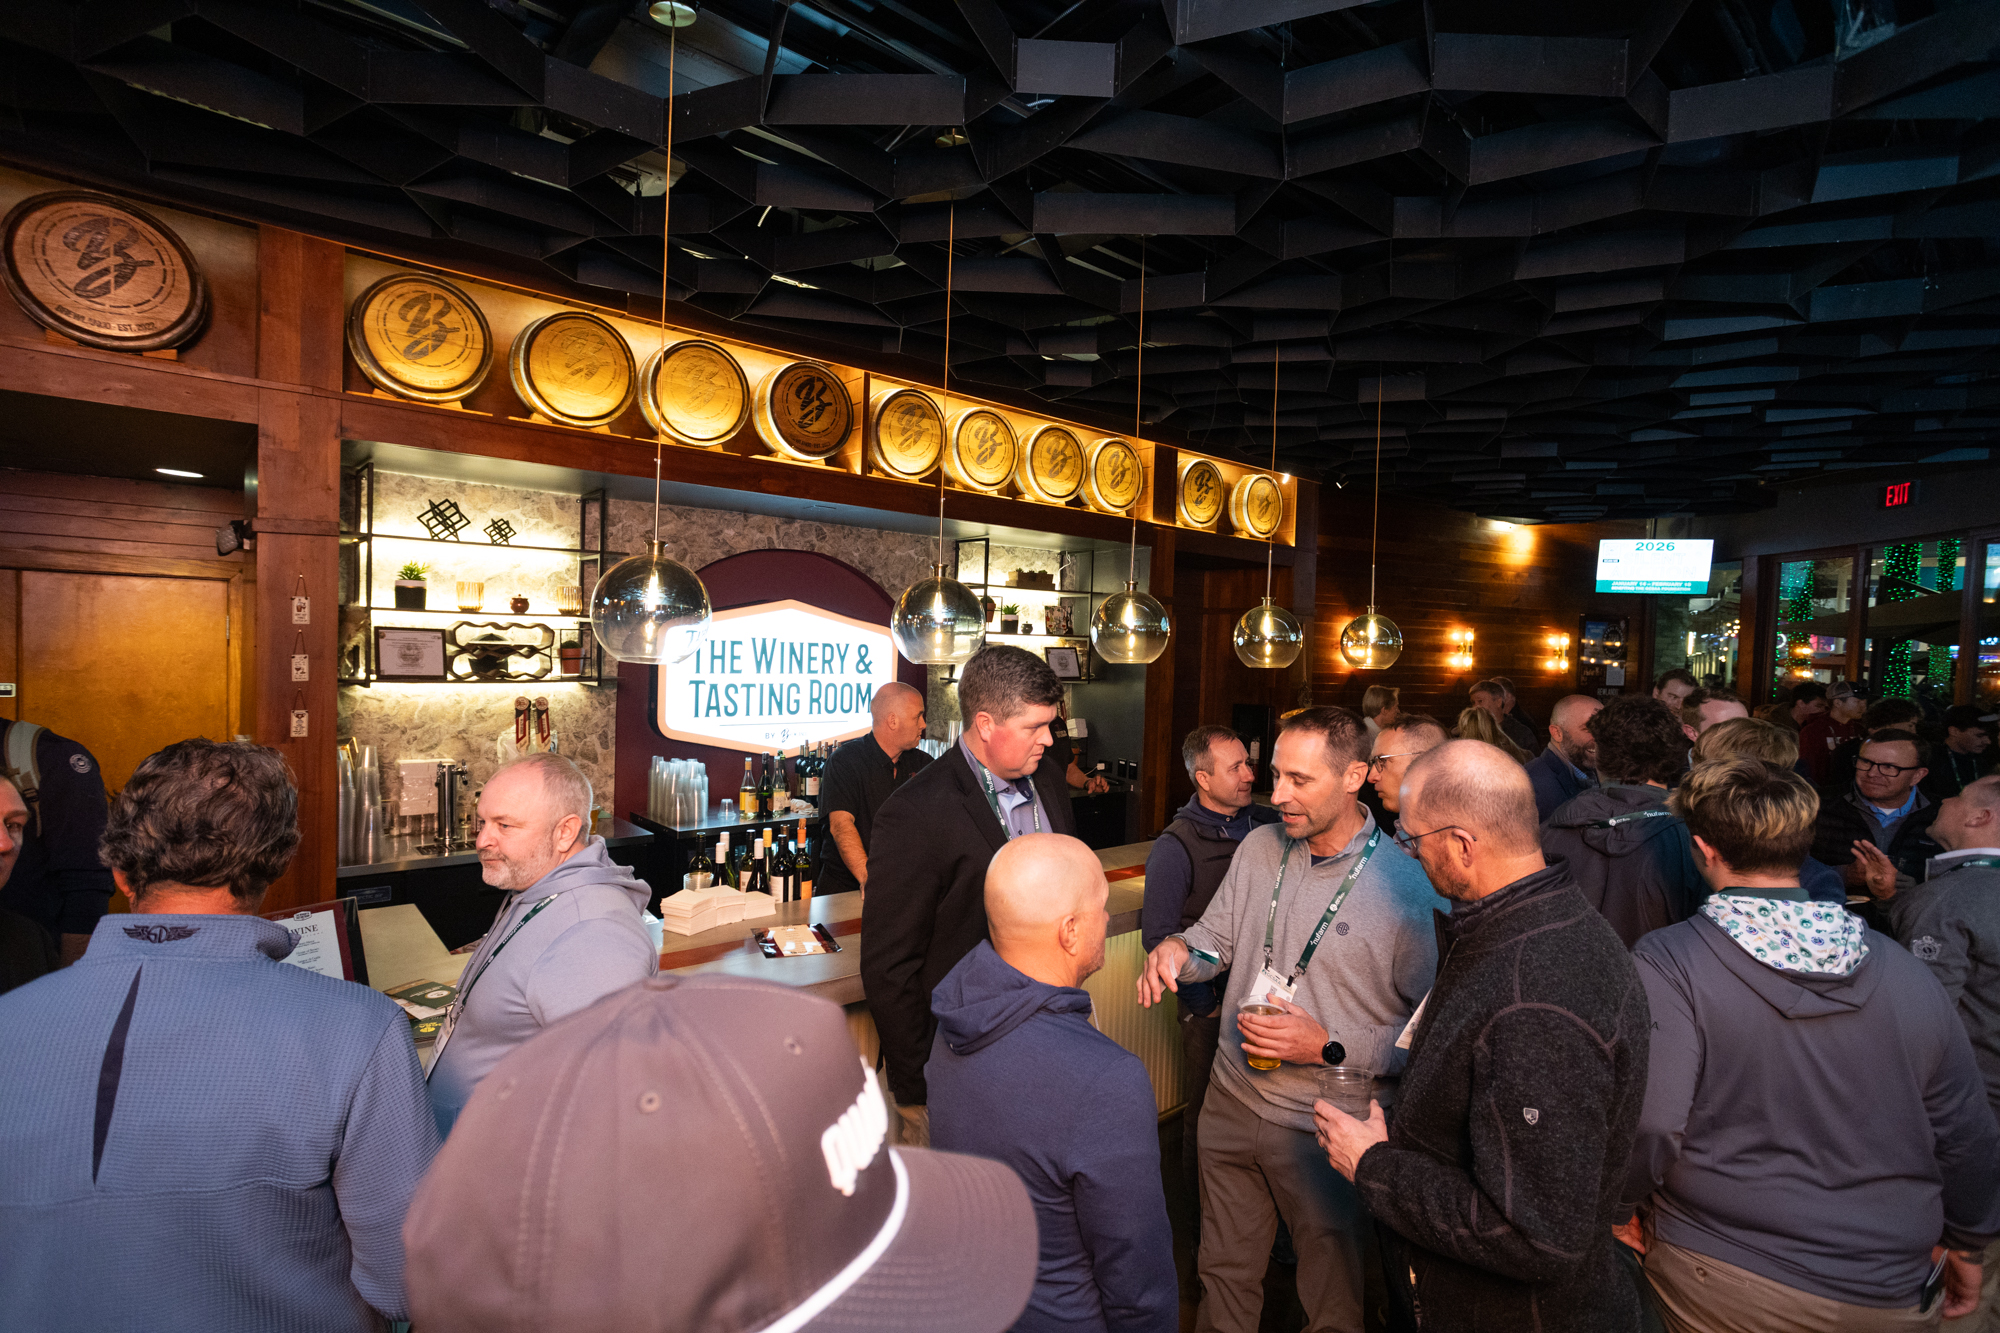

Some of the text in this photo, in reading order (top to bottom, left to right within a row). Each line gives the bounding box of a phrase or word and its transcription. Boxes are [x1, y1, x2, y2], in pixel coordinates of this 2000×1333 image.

[1886, 482, 1911, 507] EXIT
[1635, 541, 1675, 551] 2026
[751, 637, 850, 675] WINERY
[855, 643, 873, 675] &
[688, 679, 873, 718] TASTING ROOM
[764, 732, 776, 740] BY
[984, 768, 995, 792] nufarm
[1274, 866, 1285, 889] nufarm
[1351, 856, 1369, 880] nufarm
[290, 924, 319, 937] WINE
[1313, 921, 1329, 946] nufarm
